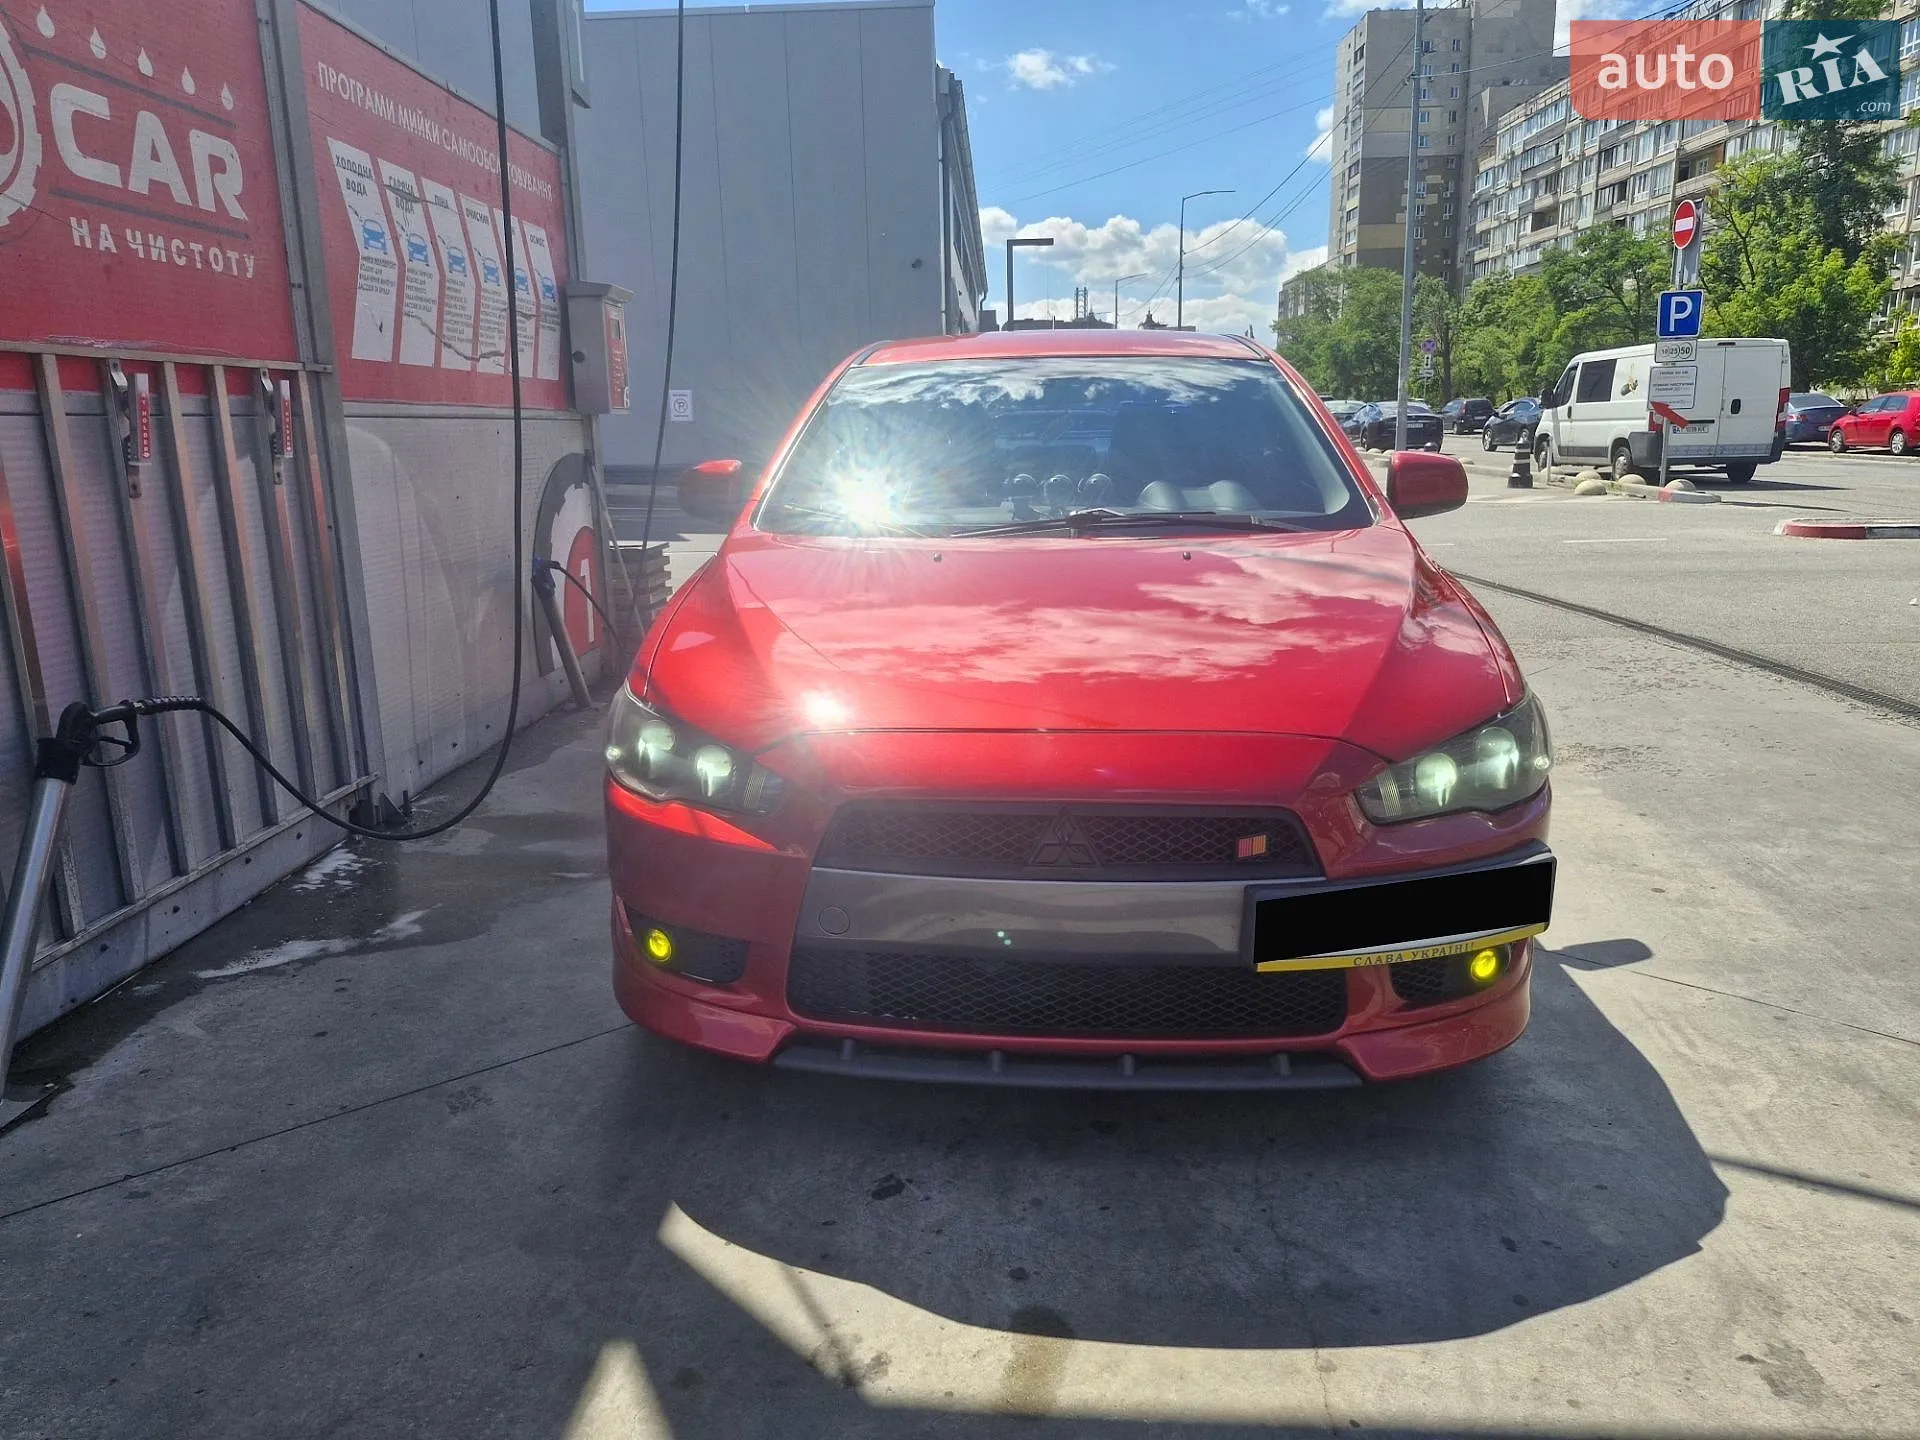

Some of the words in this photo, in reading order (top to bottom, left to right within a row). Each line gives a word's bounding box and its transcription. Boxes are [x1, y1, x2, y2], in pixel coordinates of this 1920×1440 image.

[318, 61, 396, 124] ПРОГРАМИ
[399, 103, 441, 145] МИЙКИ
[50, 83, 248, 221] CAR
[335, 154, 373, 179] ХОЛОДНА
[346, 178, 368, 197] ВОДА
[70, 216, 117, 253] НА
[125, 228, 255, 279] ЧИСТОТУ
[1669, 296, 1692, 332] P
[1680, 346, 1690, 355] 50
[580, 558, 595, 642] 1
[1353, 952, 1405, 967] СЛАВА
